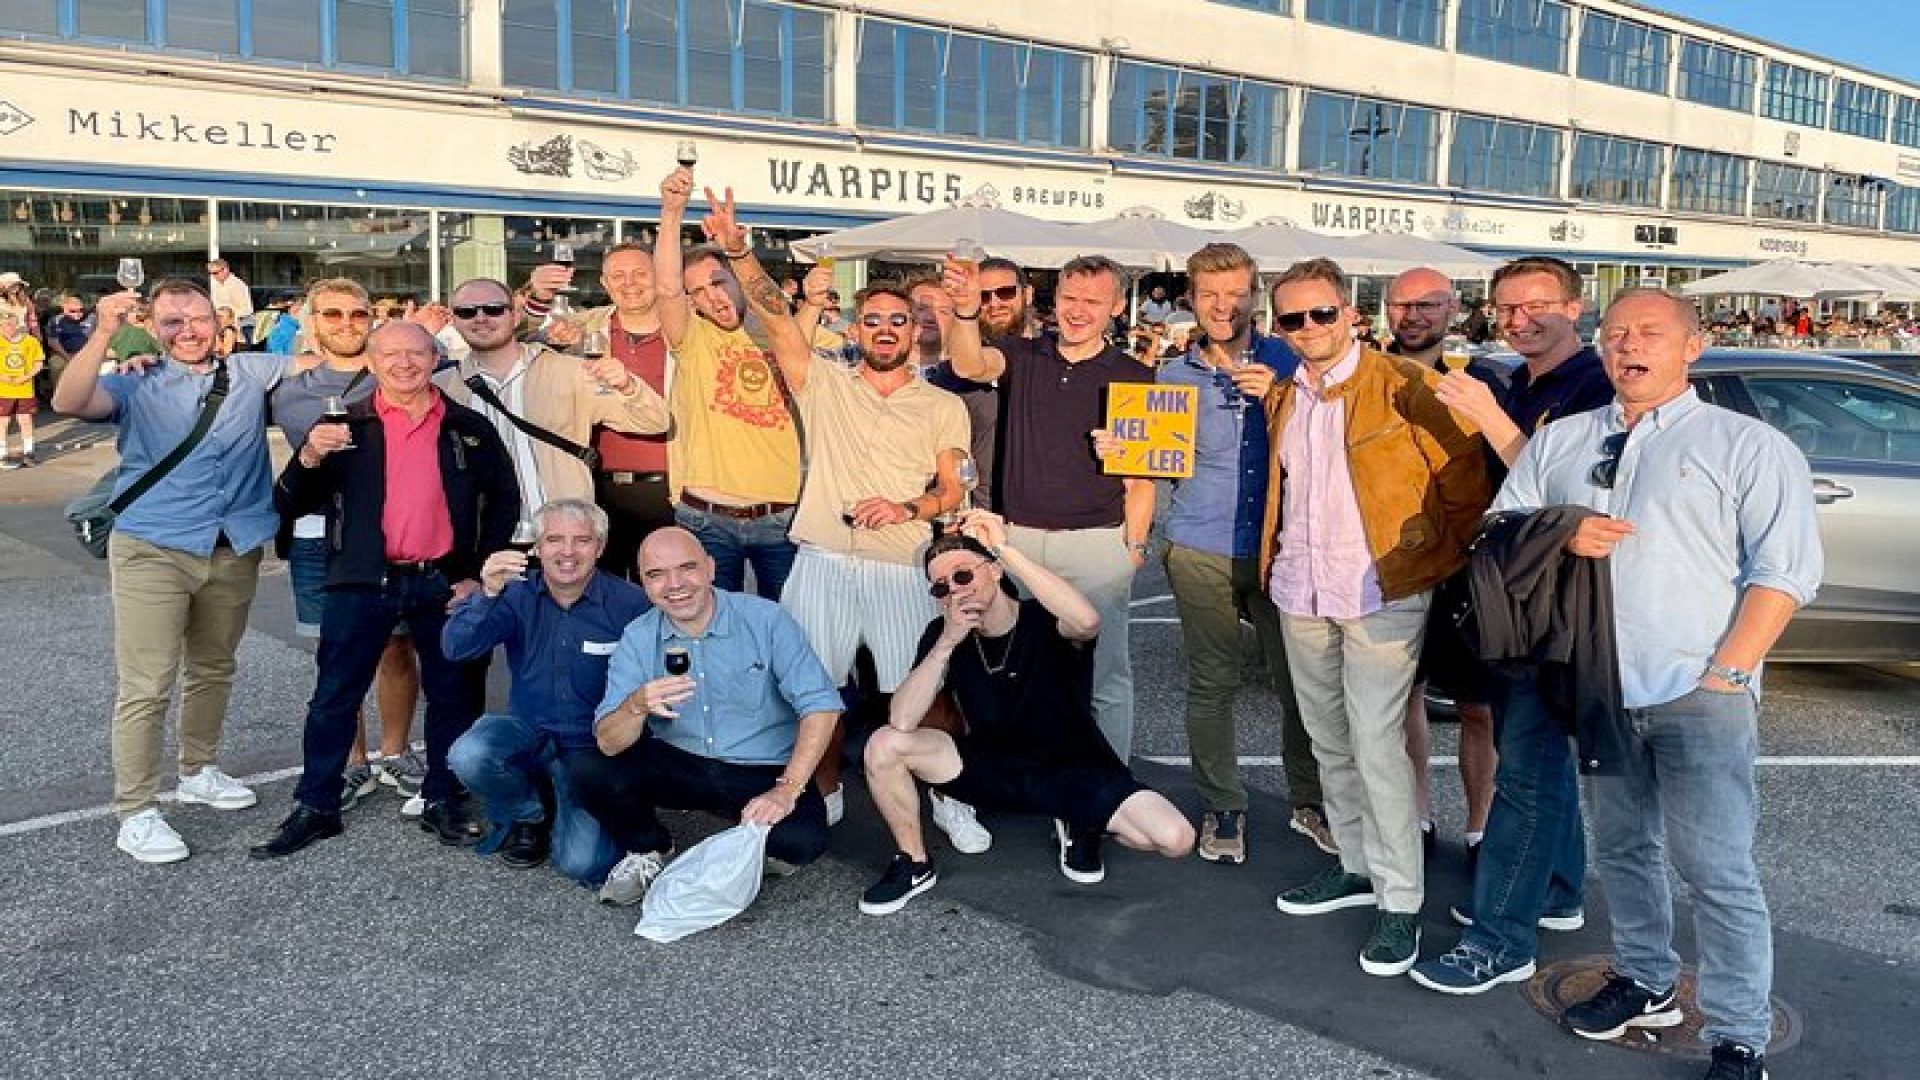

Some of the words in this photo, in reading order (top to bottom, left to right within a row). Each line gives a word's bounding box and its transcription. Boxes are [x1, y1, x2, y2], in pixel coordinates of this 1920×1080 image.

[67, 107, 338, 154] Mikkeller
[768, 157, 964, 204] WARPIGS
[1012, 186, 1105, 208] BREWPUB
[1311, 202, 1415, 233] WARPIGS
[1147, 391, 1189, 414] MIK
[1114, 417, 1150, 441] KEL
[1146, 449, 1185, 474] LER
